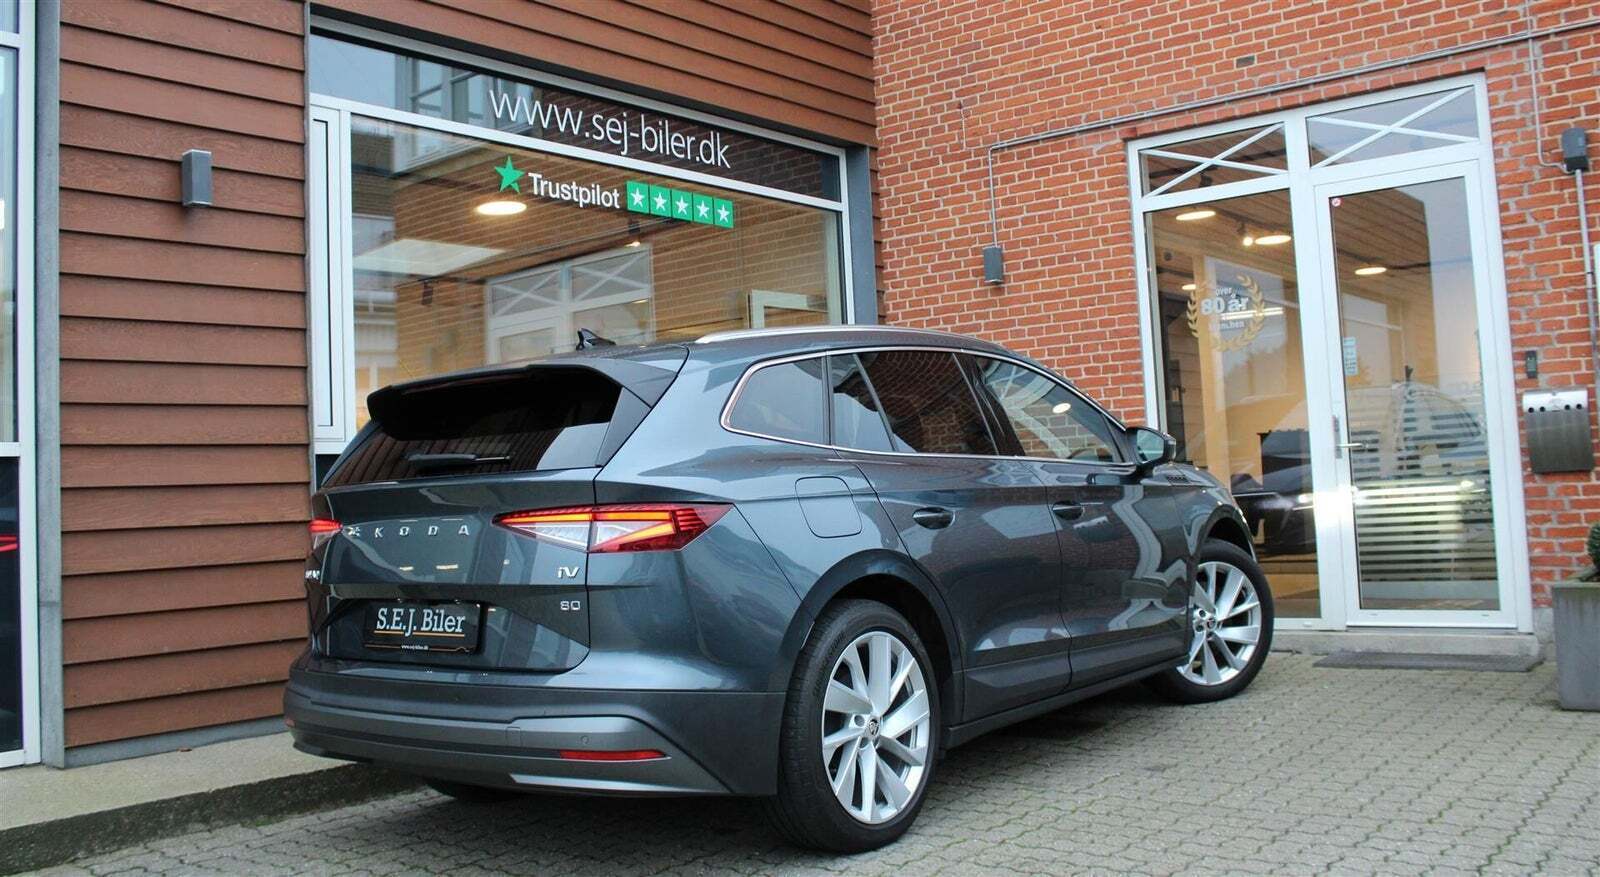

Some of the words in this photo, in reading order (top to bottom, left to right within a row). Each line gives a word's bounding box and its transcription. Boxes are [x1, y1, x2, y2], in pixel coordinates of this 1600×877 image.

[489, 90, 731, 168] www.sej-biler.dk
[528, 172, 620, 209] Trustpilot
[1200, 298, 1225, 315] 80
[560, 600, 581, 611] 80
[376, 607, 417, 637] S.E.J.
[421, 608, 466, 633] Biler
